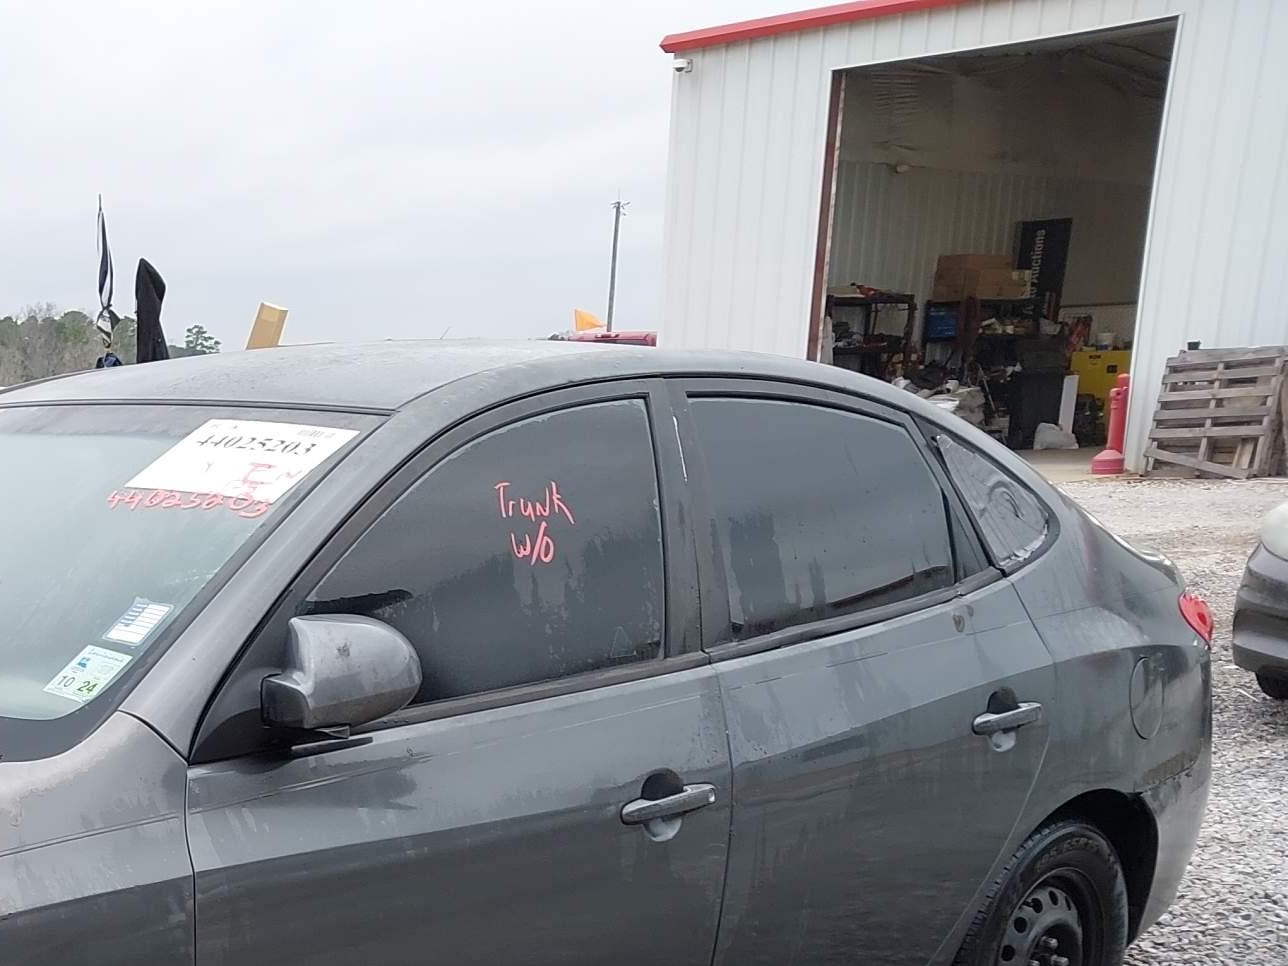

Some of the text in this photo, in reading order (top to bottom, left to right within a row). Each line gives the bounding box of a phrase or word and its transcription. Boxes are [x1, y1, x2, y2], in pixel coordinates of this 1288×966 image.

[1031, 228, 1046, 284] Auctions
[196, 433, 318, 456] 44025203
[57, 675, 98, 694] 10 24
